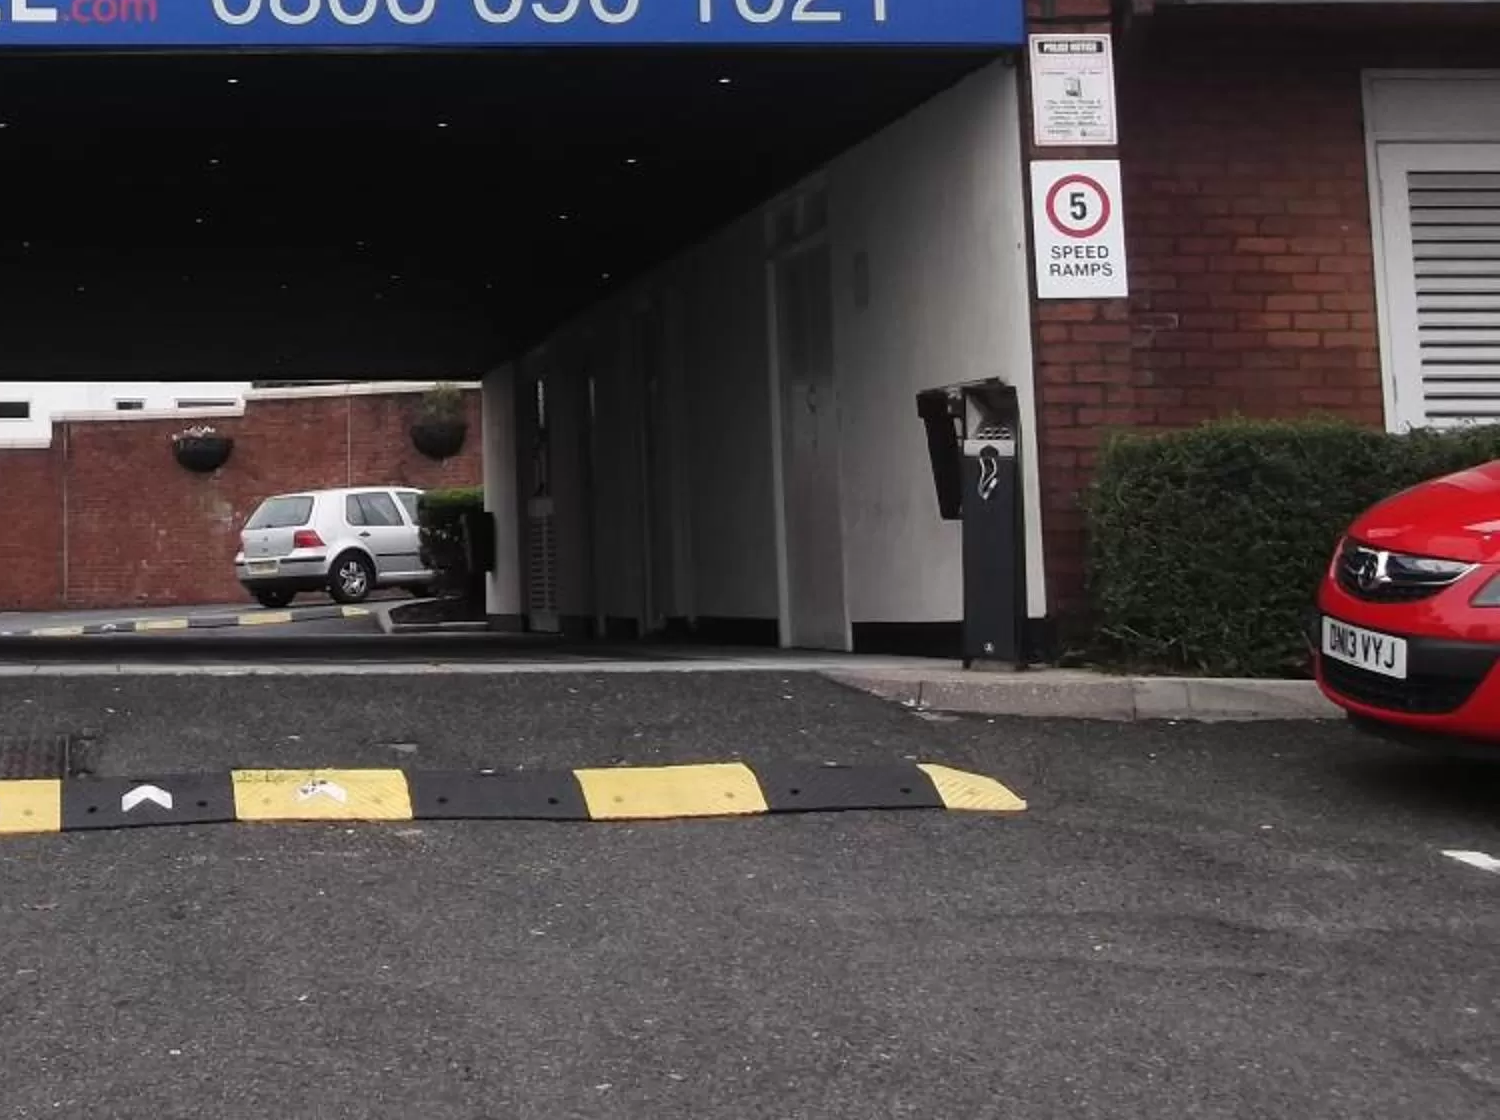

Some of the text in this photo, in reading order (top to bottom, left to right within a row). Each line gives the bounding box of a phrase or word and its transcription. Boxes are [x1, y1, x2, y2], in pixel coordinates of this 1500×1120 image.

[1069, 191, 1088, 221] 5
[1051, 245, 1110, 259] SPEED
[1049, 262, 1114, 277] RAMPS
[1361, 633, 1395, 669] VYJ
